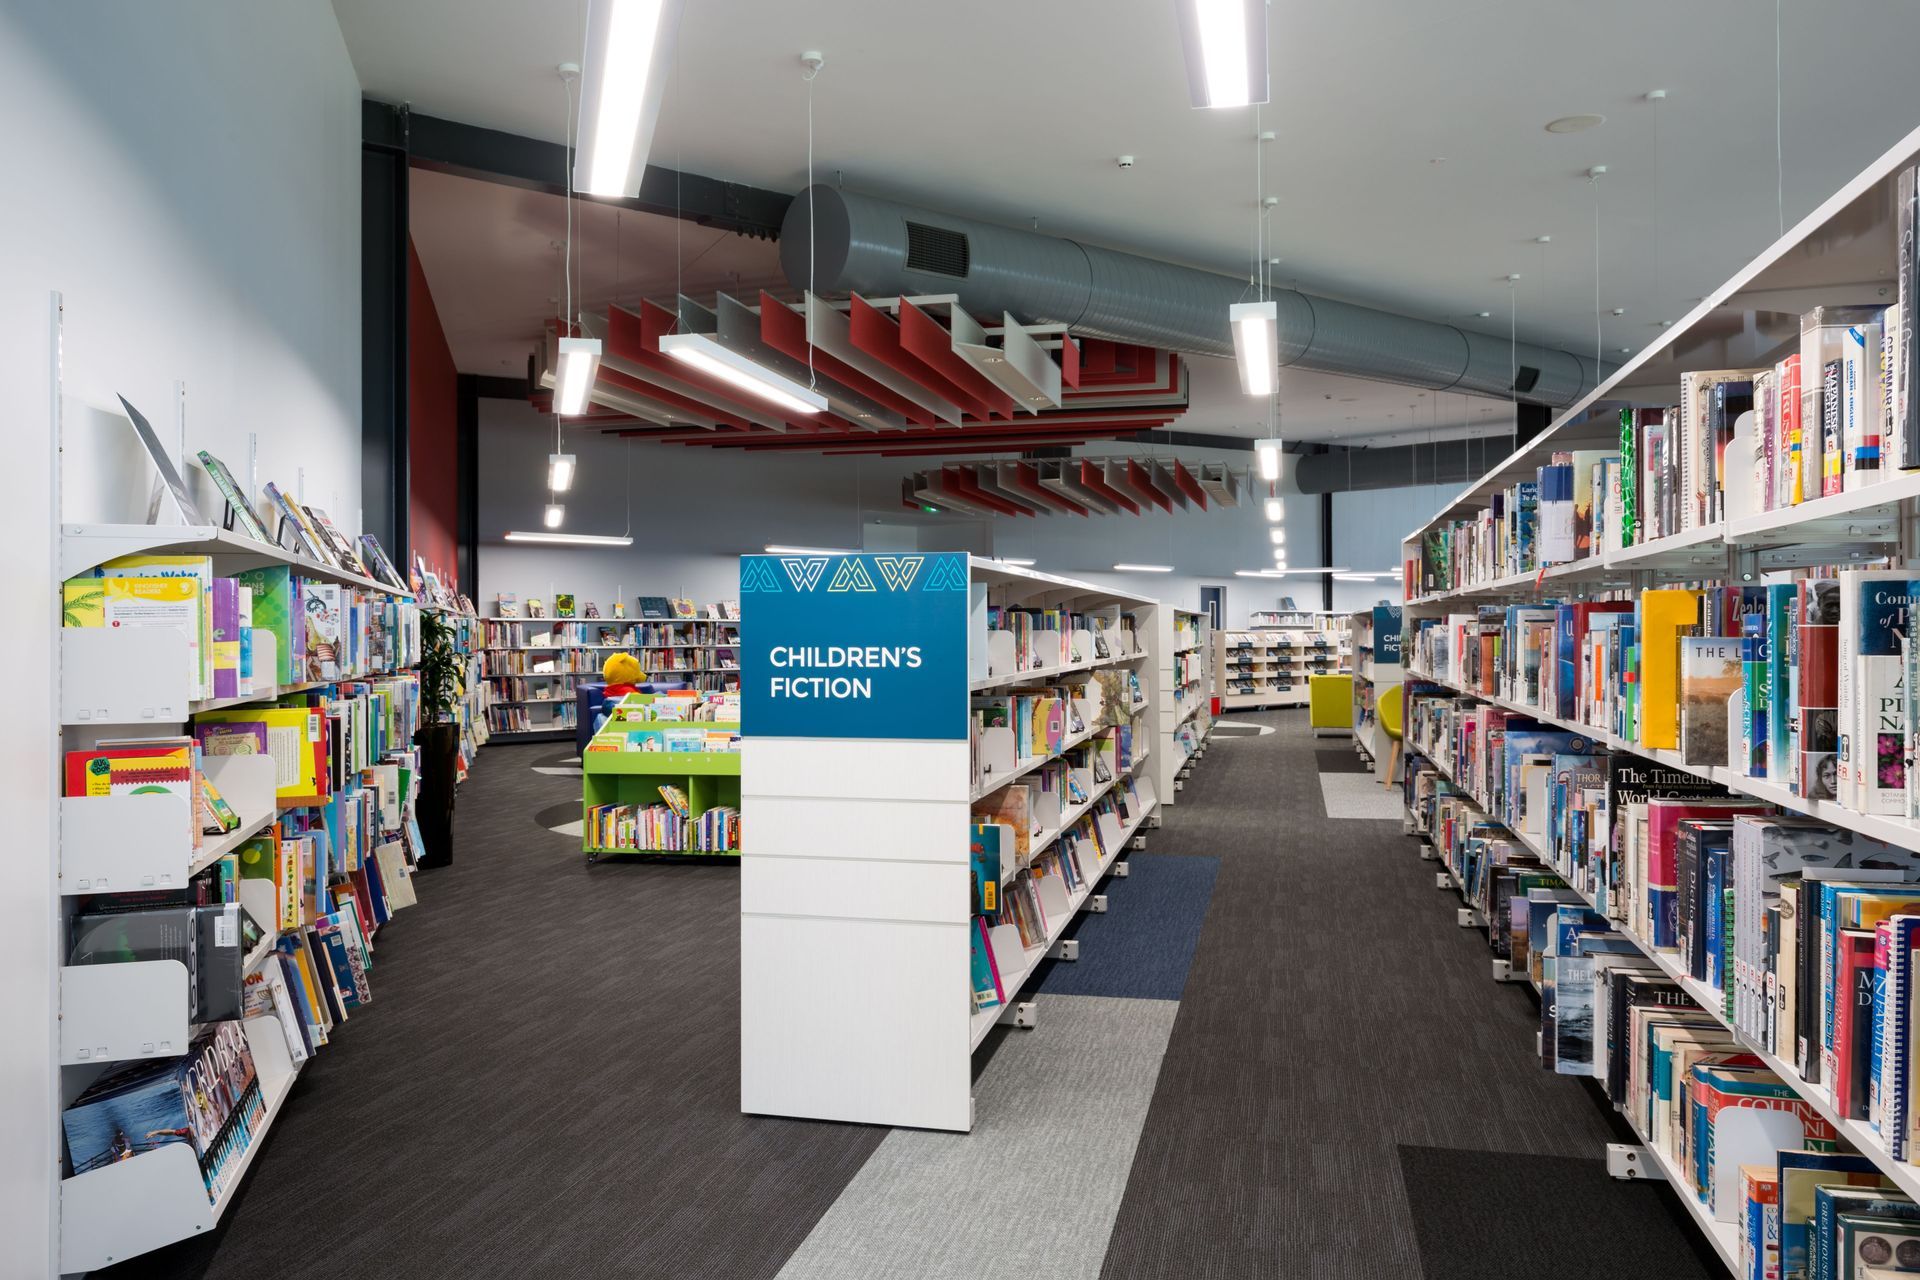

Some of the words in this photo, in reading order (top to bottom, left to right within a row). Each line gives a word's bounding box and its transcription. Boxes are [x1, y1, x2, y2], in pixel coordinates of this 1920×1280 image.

[1879, 614, 1894, 627] of
[769, 646, 922, 668] CHILDREN'S
[1695, 647, 1726, 658] THE
[770, 677, 872, 699] FICTION
[1576, 773, 1600, 783] THOR
[1617, 768, 1648, 784] The
[1568, 969, 1586, 981] THE
[1654, 991, 1689, 1006] THE
[1874, 997, 1885, 1061] FAMILY
[1773, 1089, 1790, 1098] THE
